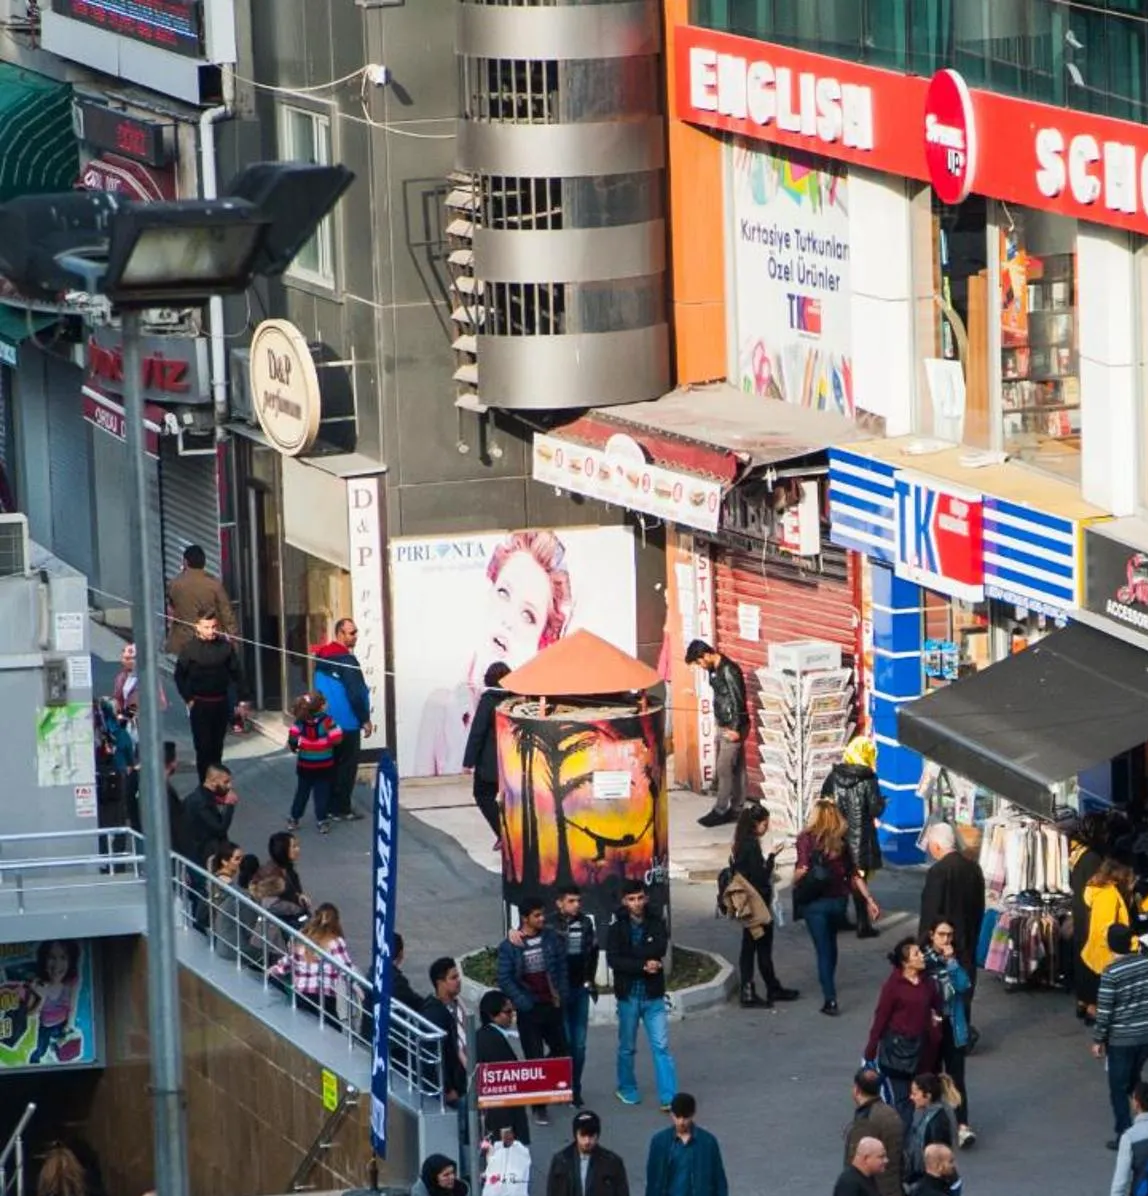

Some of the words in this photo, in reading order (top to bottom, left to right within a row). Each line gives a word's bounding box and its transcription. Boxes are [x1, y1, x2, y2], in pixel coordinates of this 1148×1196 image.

[689, 47, 874, 151] ENGLISH
[740, 217, 791, 254] Kırtasiye
[767, 249, 794, 281] Özel
[797, 256, 841, 291] Ürünler
[894, 479, 938, 575] TK
[482, 1066, 547, 1084] İSTANBUL
